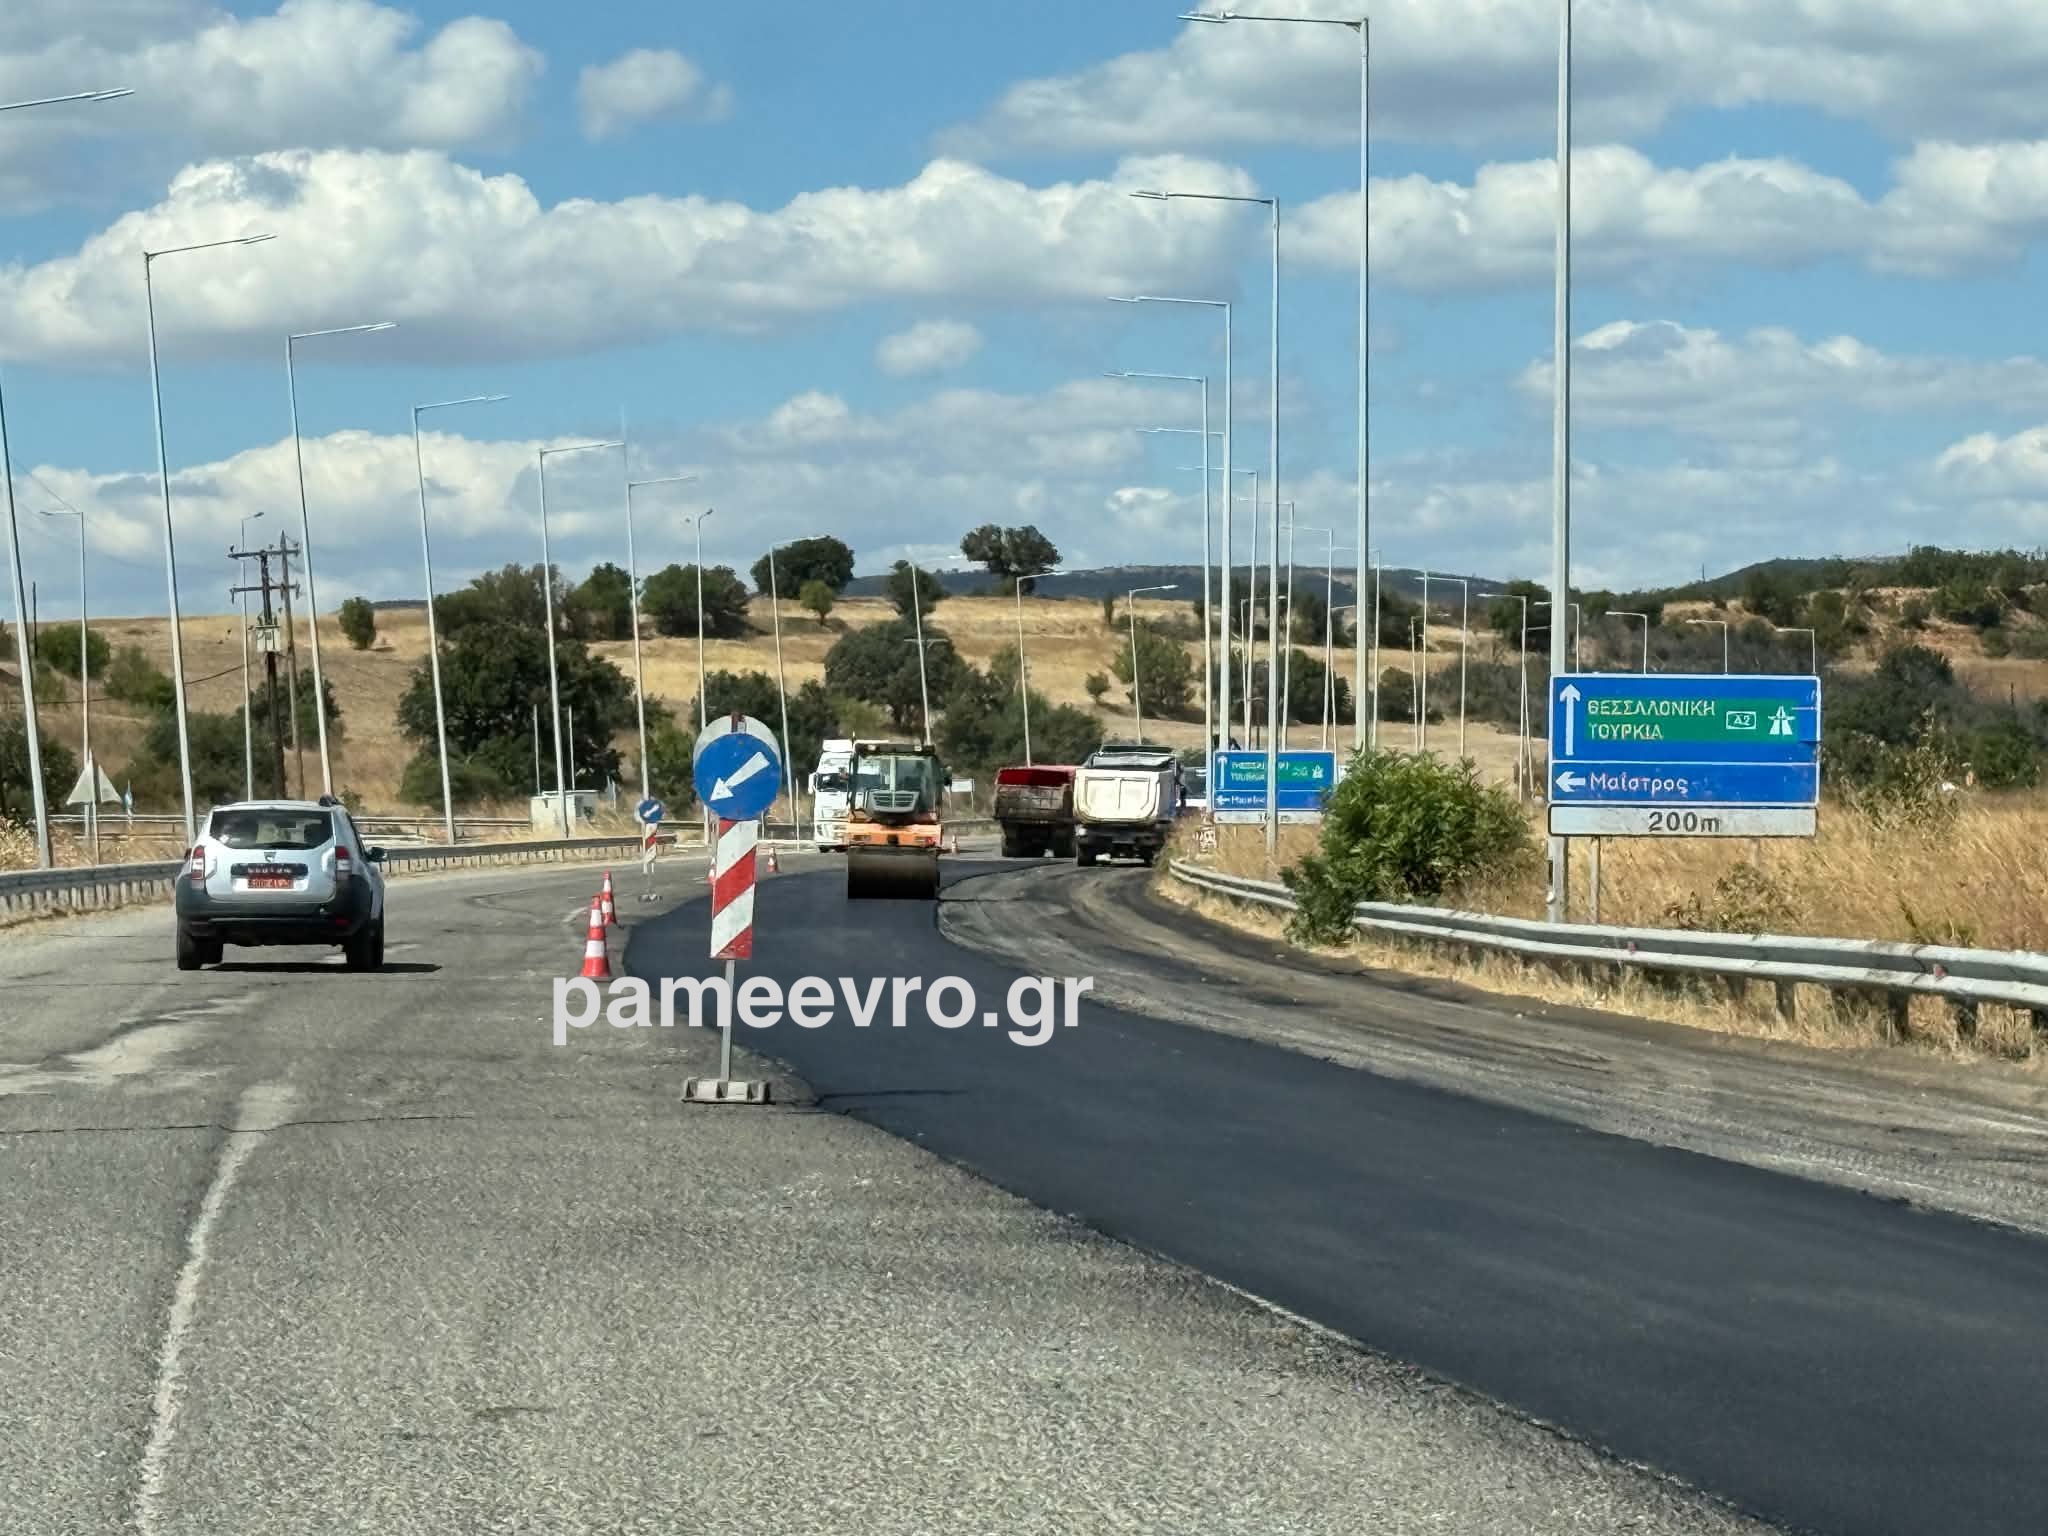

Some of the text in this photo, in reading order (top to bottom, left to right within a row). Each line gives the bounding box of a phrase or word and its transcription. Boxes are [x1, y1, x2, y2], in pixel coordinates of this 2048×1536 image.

[1588, 700, 1715, 716] ΘΕΣΣΑΛΟΝΙΚΗ
[1589, 723, 1664, 740] ΤΟΥΡΚΙΑ
[1649, 811, 1721, 833] 200m
